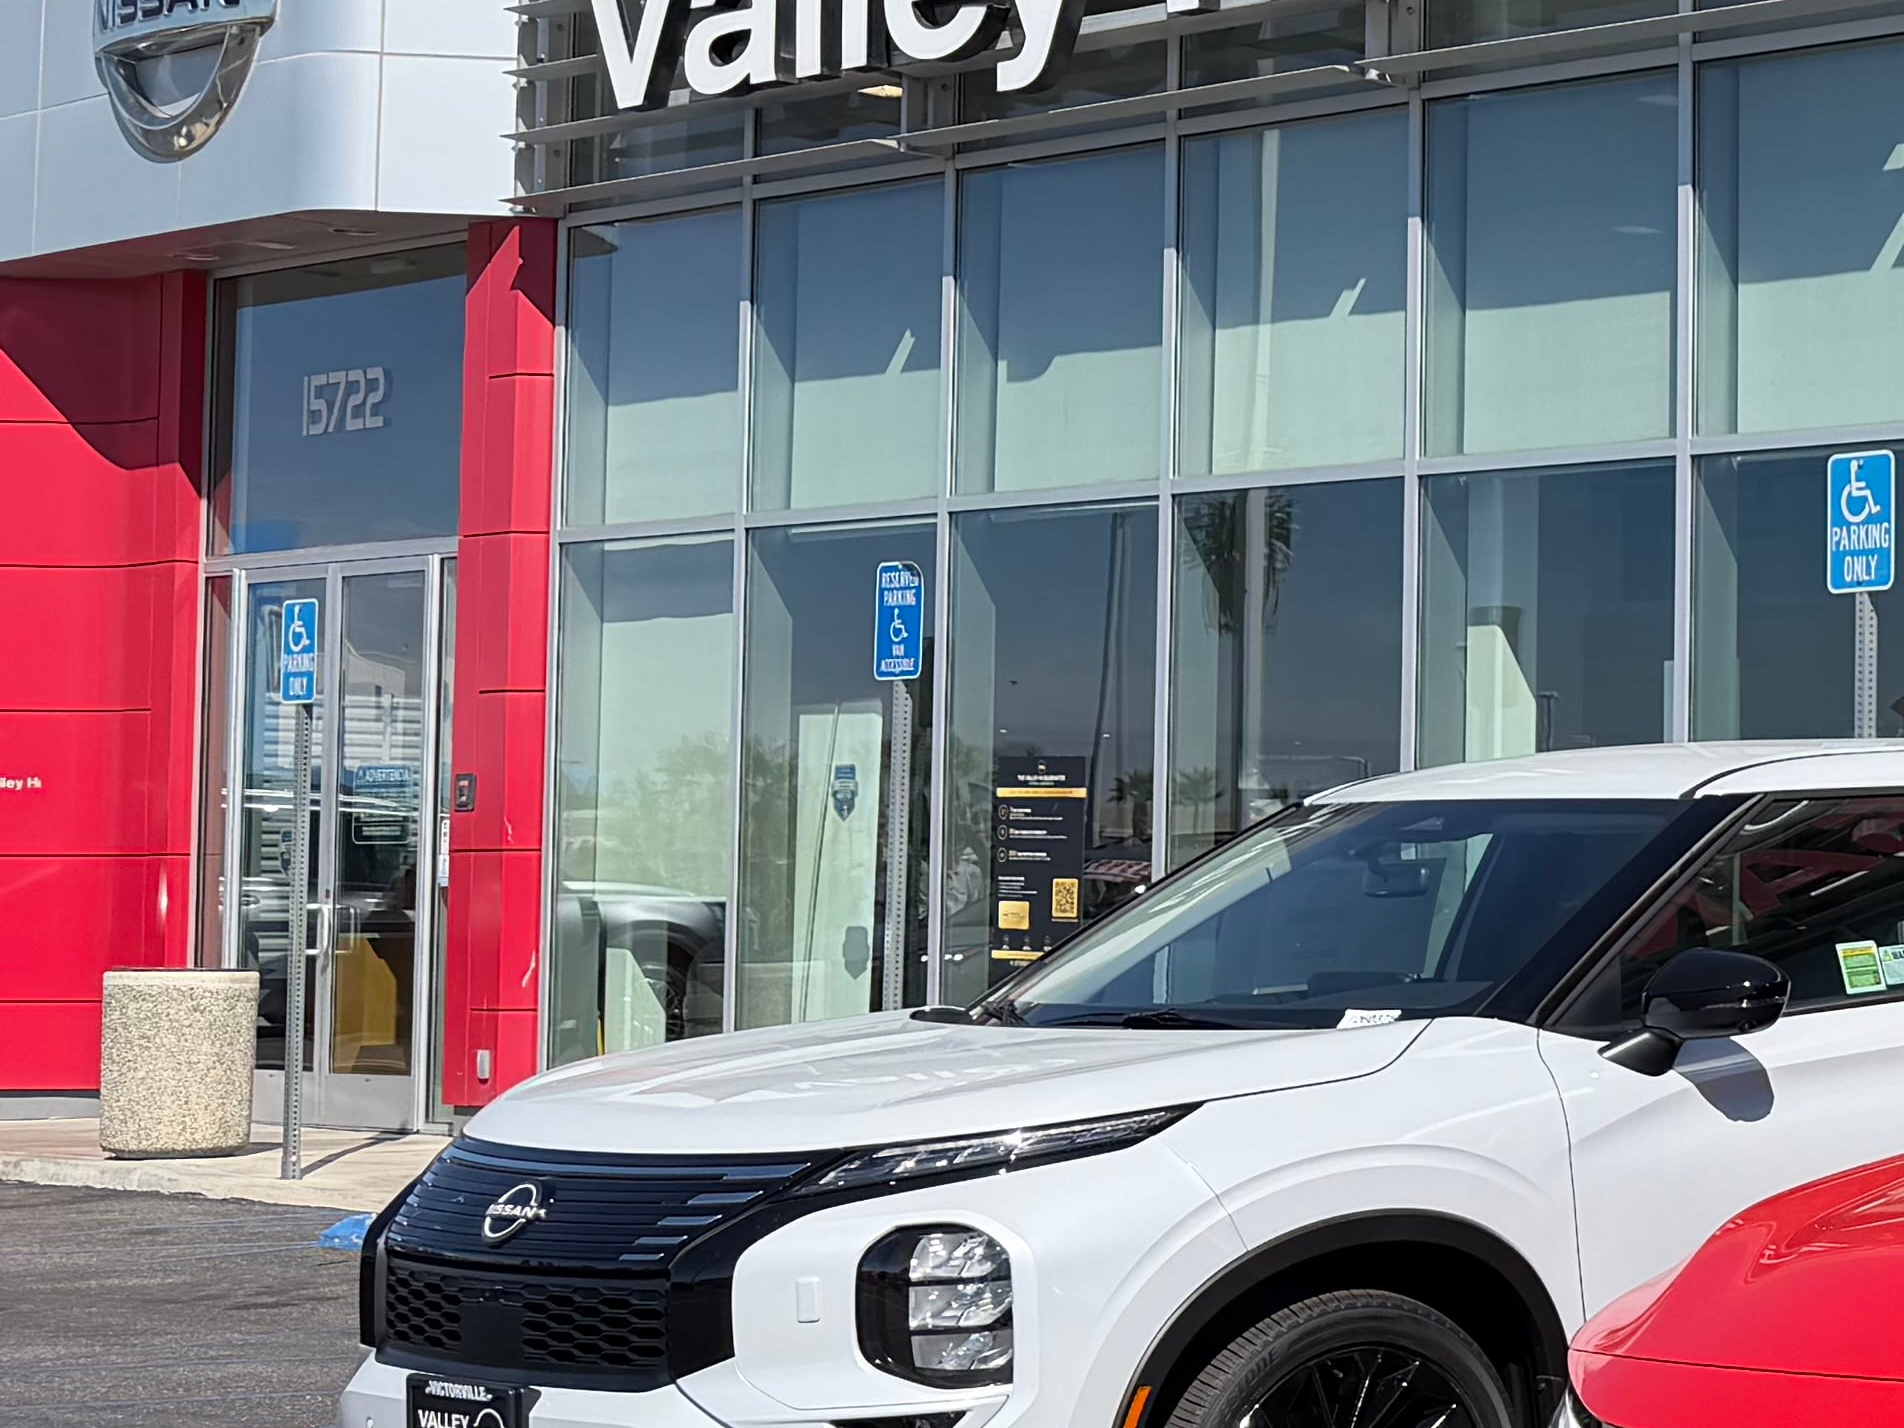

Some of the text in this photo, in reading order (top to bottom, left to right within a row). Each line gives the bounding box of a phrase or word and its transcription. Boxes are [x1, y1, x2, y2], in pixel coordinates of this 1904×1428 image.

[302, 366, 386, 436] 15722
[1832, 521, 1890, 551] PARKING
[1844, 554, 1878, 582] ONLY
[884, 589, 916, 606] PARKING
[283, 653, 314, 672] PARKING
[289, 676, 307, 695] ONLY
[428, 1380, 489, 1401] VICTORVILLE
